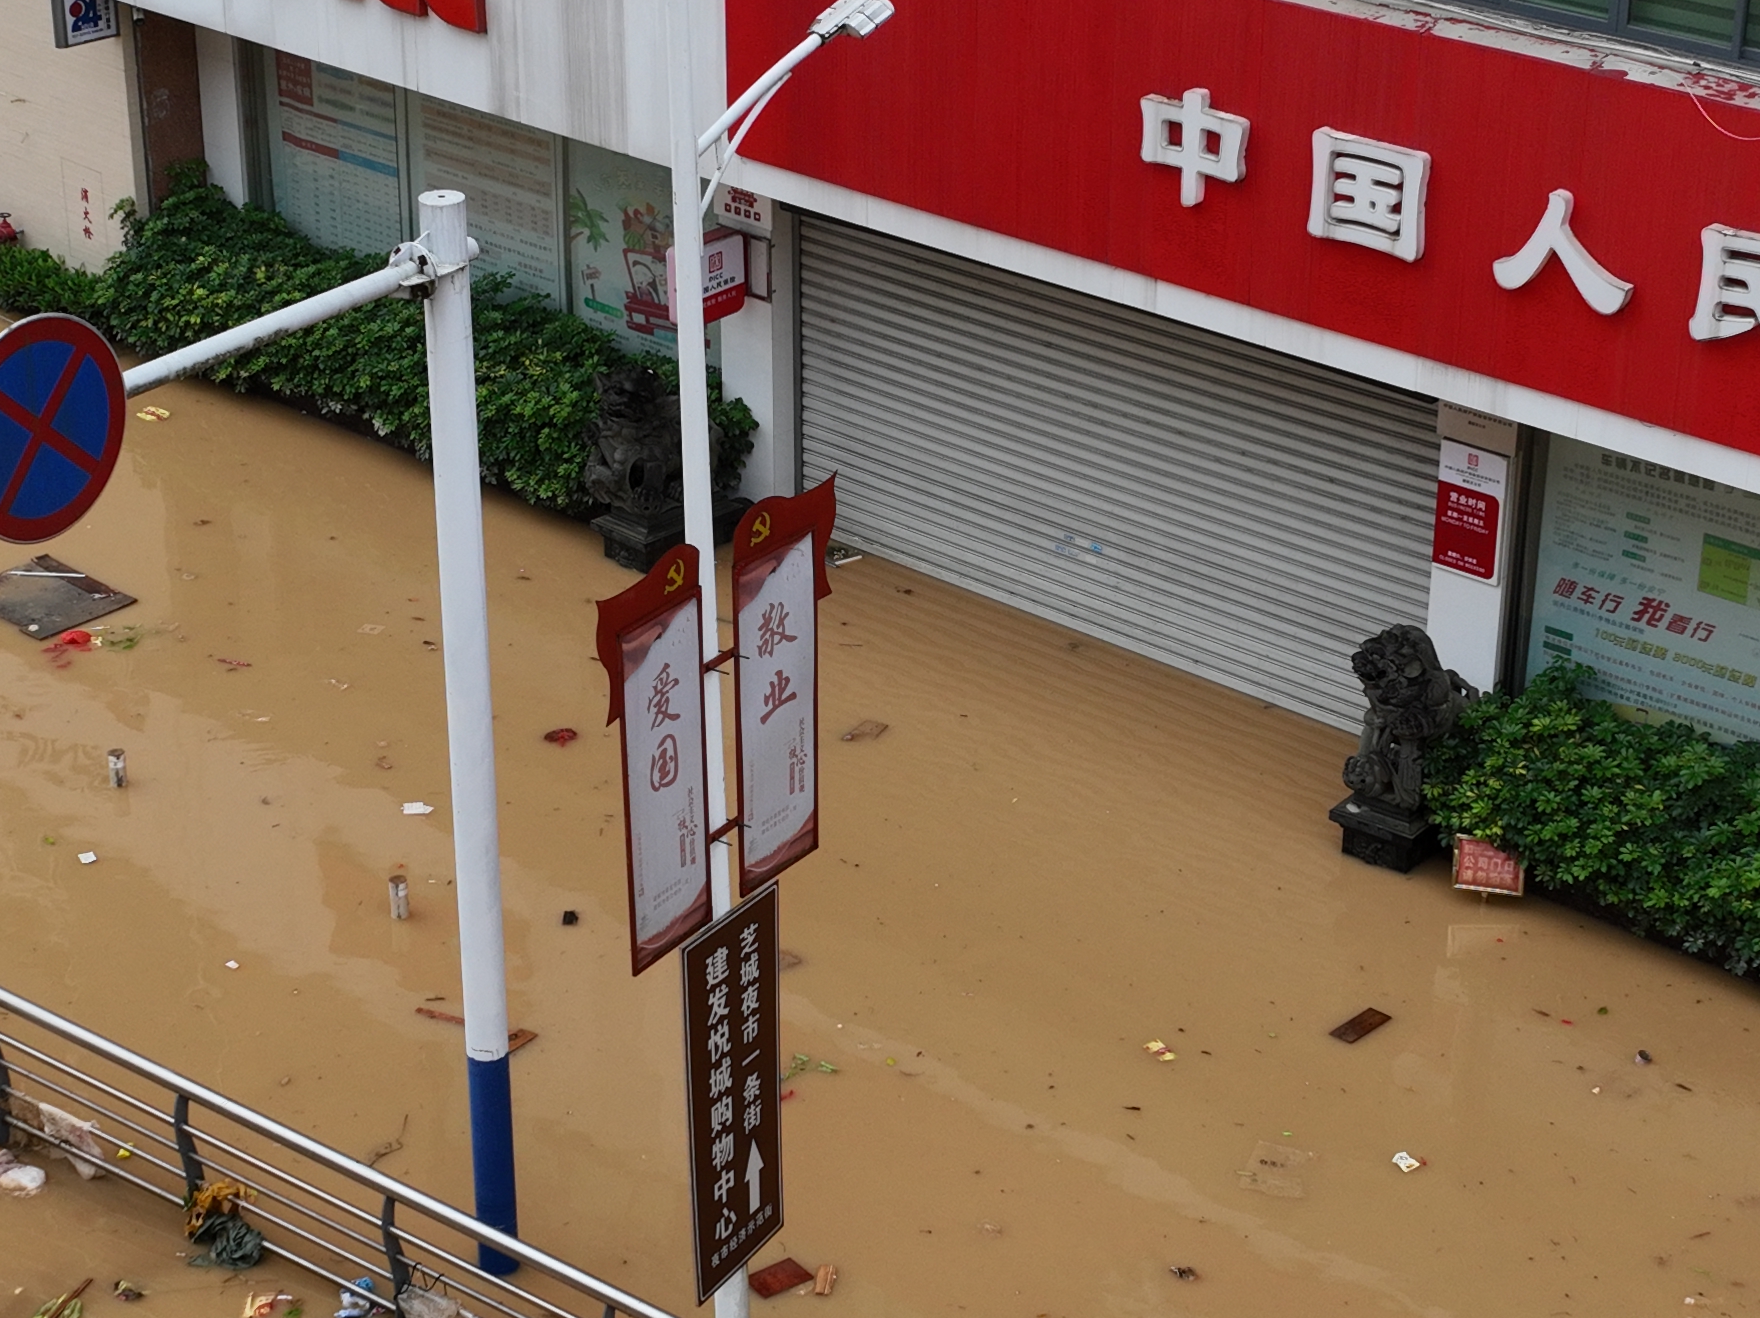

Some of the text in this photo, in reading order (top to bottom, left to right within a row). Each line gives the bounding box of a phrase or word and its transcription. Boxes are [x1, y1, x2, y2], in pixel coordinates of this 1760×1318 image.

[757, 602, 798, 725] 敬业
[1553, 578, 1717, 643] 随车行 我看行
[647, 662, 681, 792] 爱国
[740, 922, 762, 1134] 芝城夜市一条街
[705, 946, 737, 1241] 建发悦城购物中心
